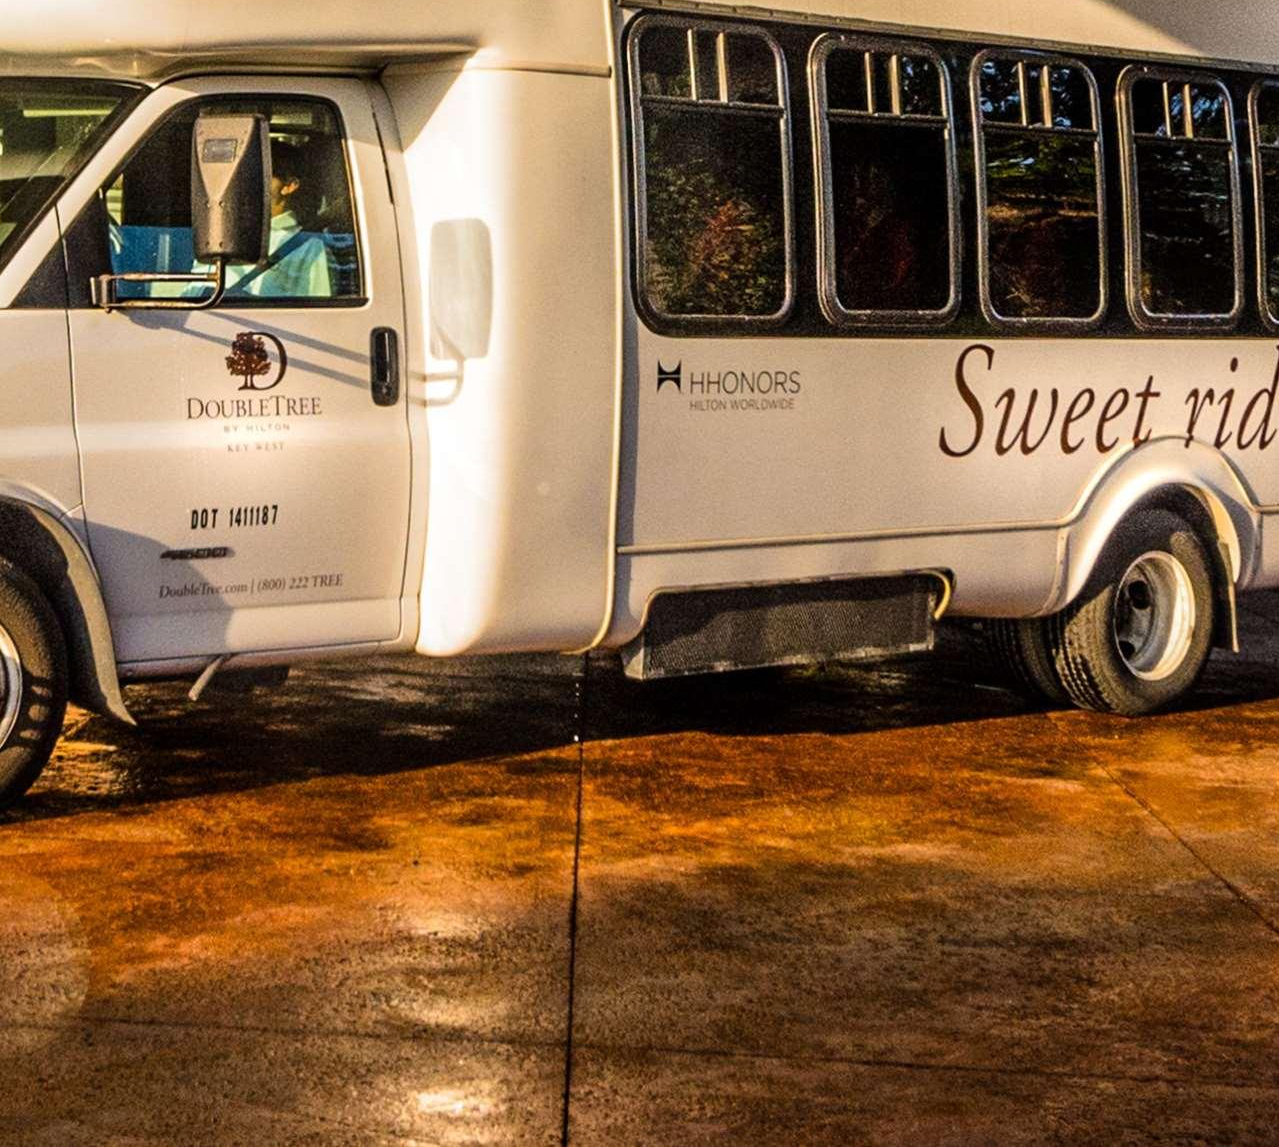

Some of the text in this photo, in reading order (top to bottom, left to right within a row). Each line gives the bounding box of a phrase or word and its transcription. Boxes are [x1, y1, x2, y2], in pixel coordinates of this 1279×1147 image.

[689, 370, 801, 394] HHONORS
[689, 398, 795, 411] HILTON WORLDWIDE
[938, 343, 1161, 457] Sweet
[191, 505, 278, 530] DOT 1411187
[159, 581, 248, 599] DoubleTree.com
[257, 577, 286, 593] (800)
[289, 577, 308, 590] 222
[312, 574, 344, 589] TREE
